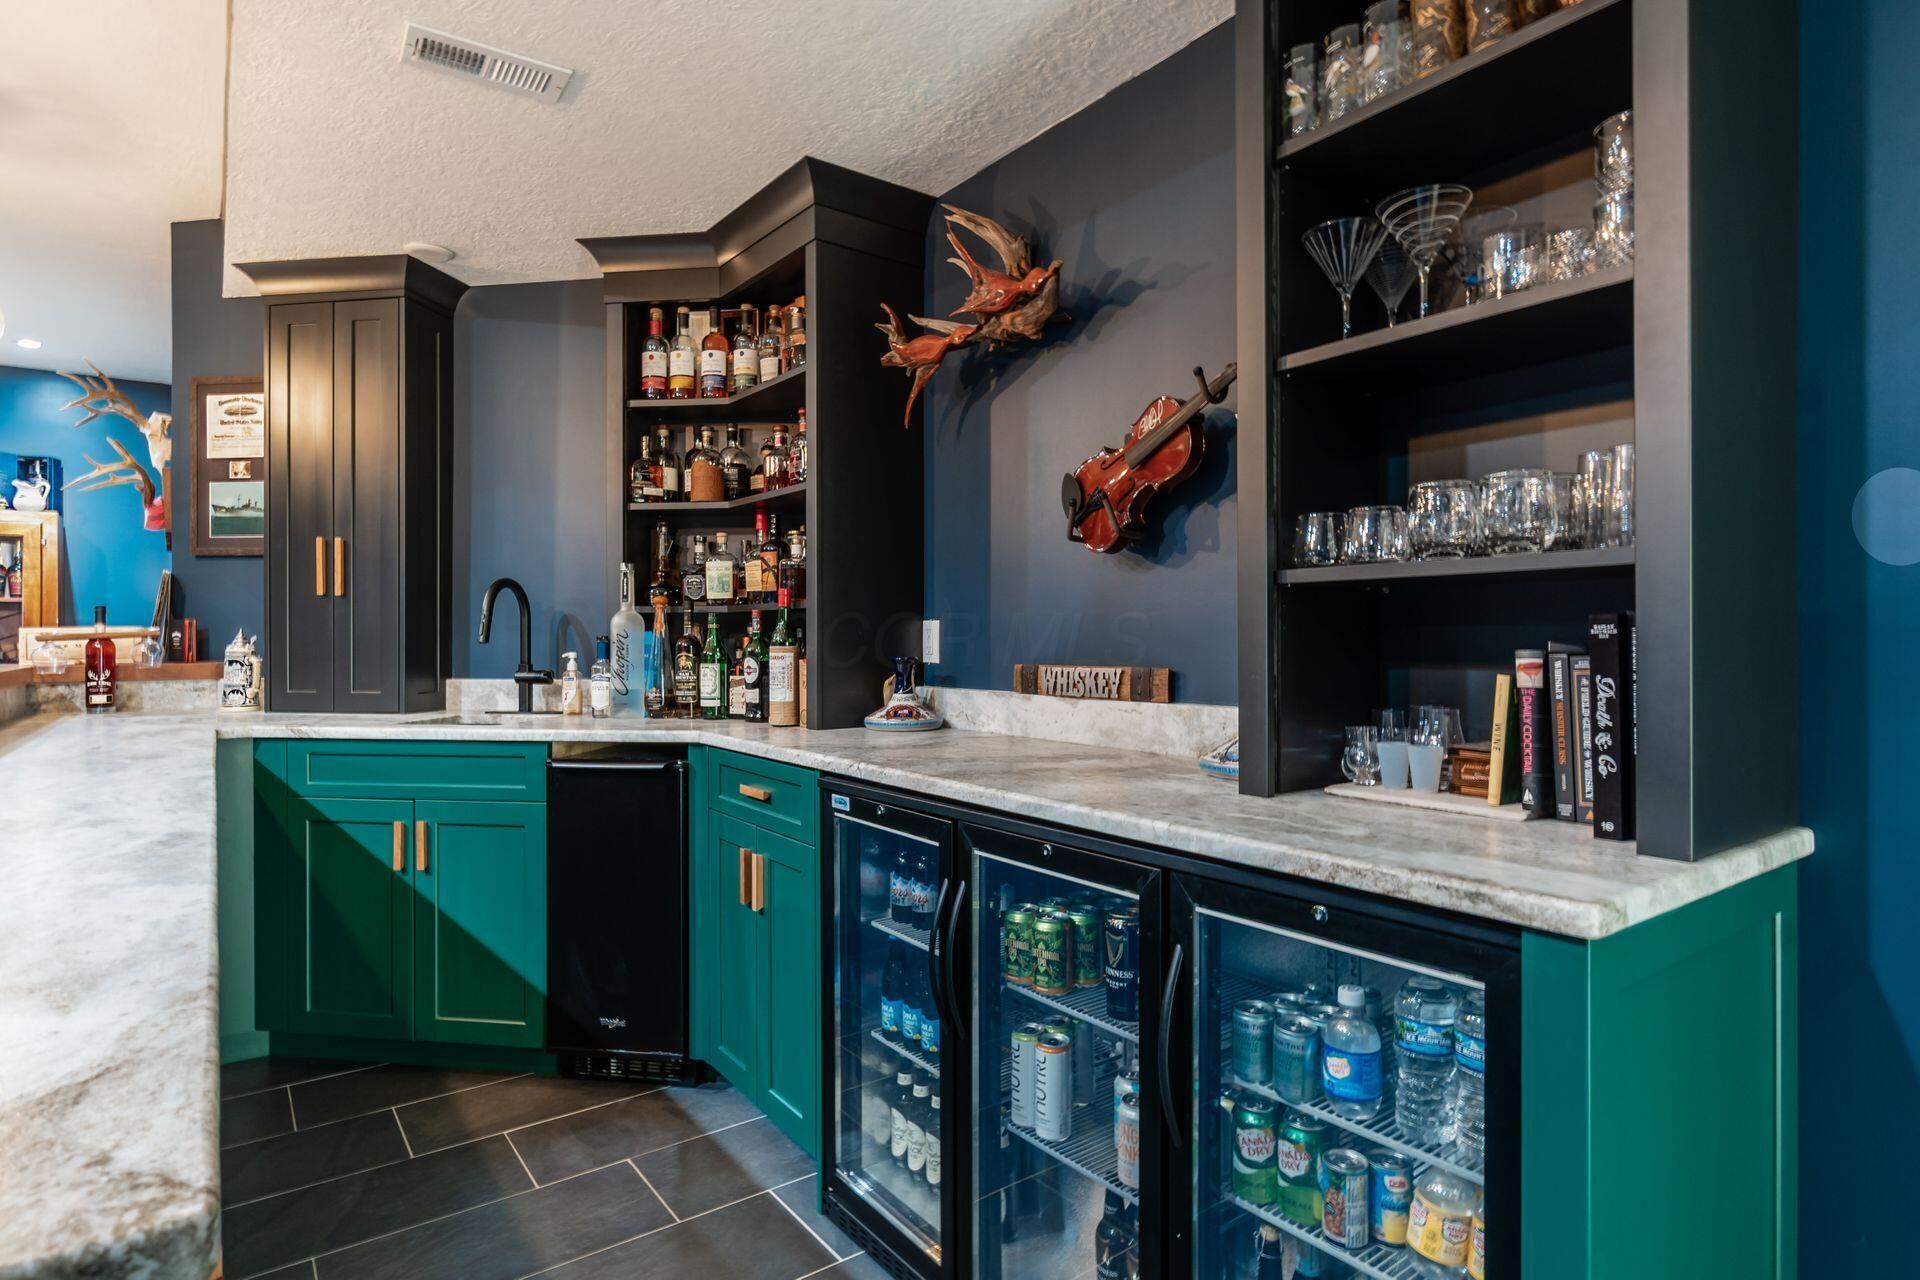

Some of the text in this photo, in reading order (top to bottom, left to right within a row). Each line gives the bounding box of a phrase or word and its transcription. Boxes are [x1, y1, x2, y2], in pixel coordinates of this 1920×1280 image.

[613, 628, 635, 697] Chopin
[1043, 667, 1122, 699] WHISKEY
[1520, 688, 1536, 696] THE
[1595, 674, 1616, 730] Death
[1522, 695, 1533, 776] DAILY COCKTAIL
[1598, 754, 1617, 779] Co
